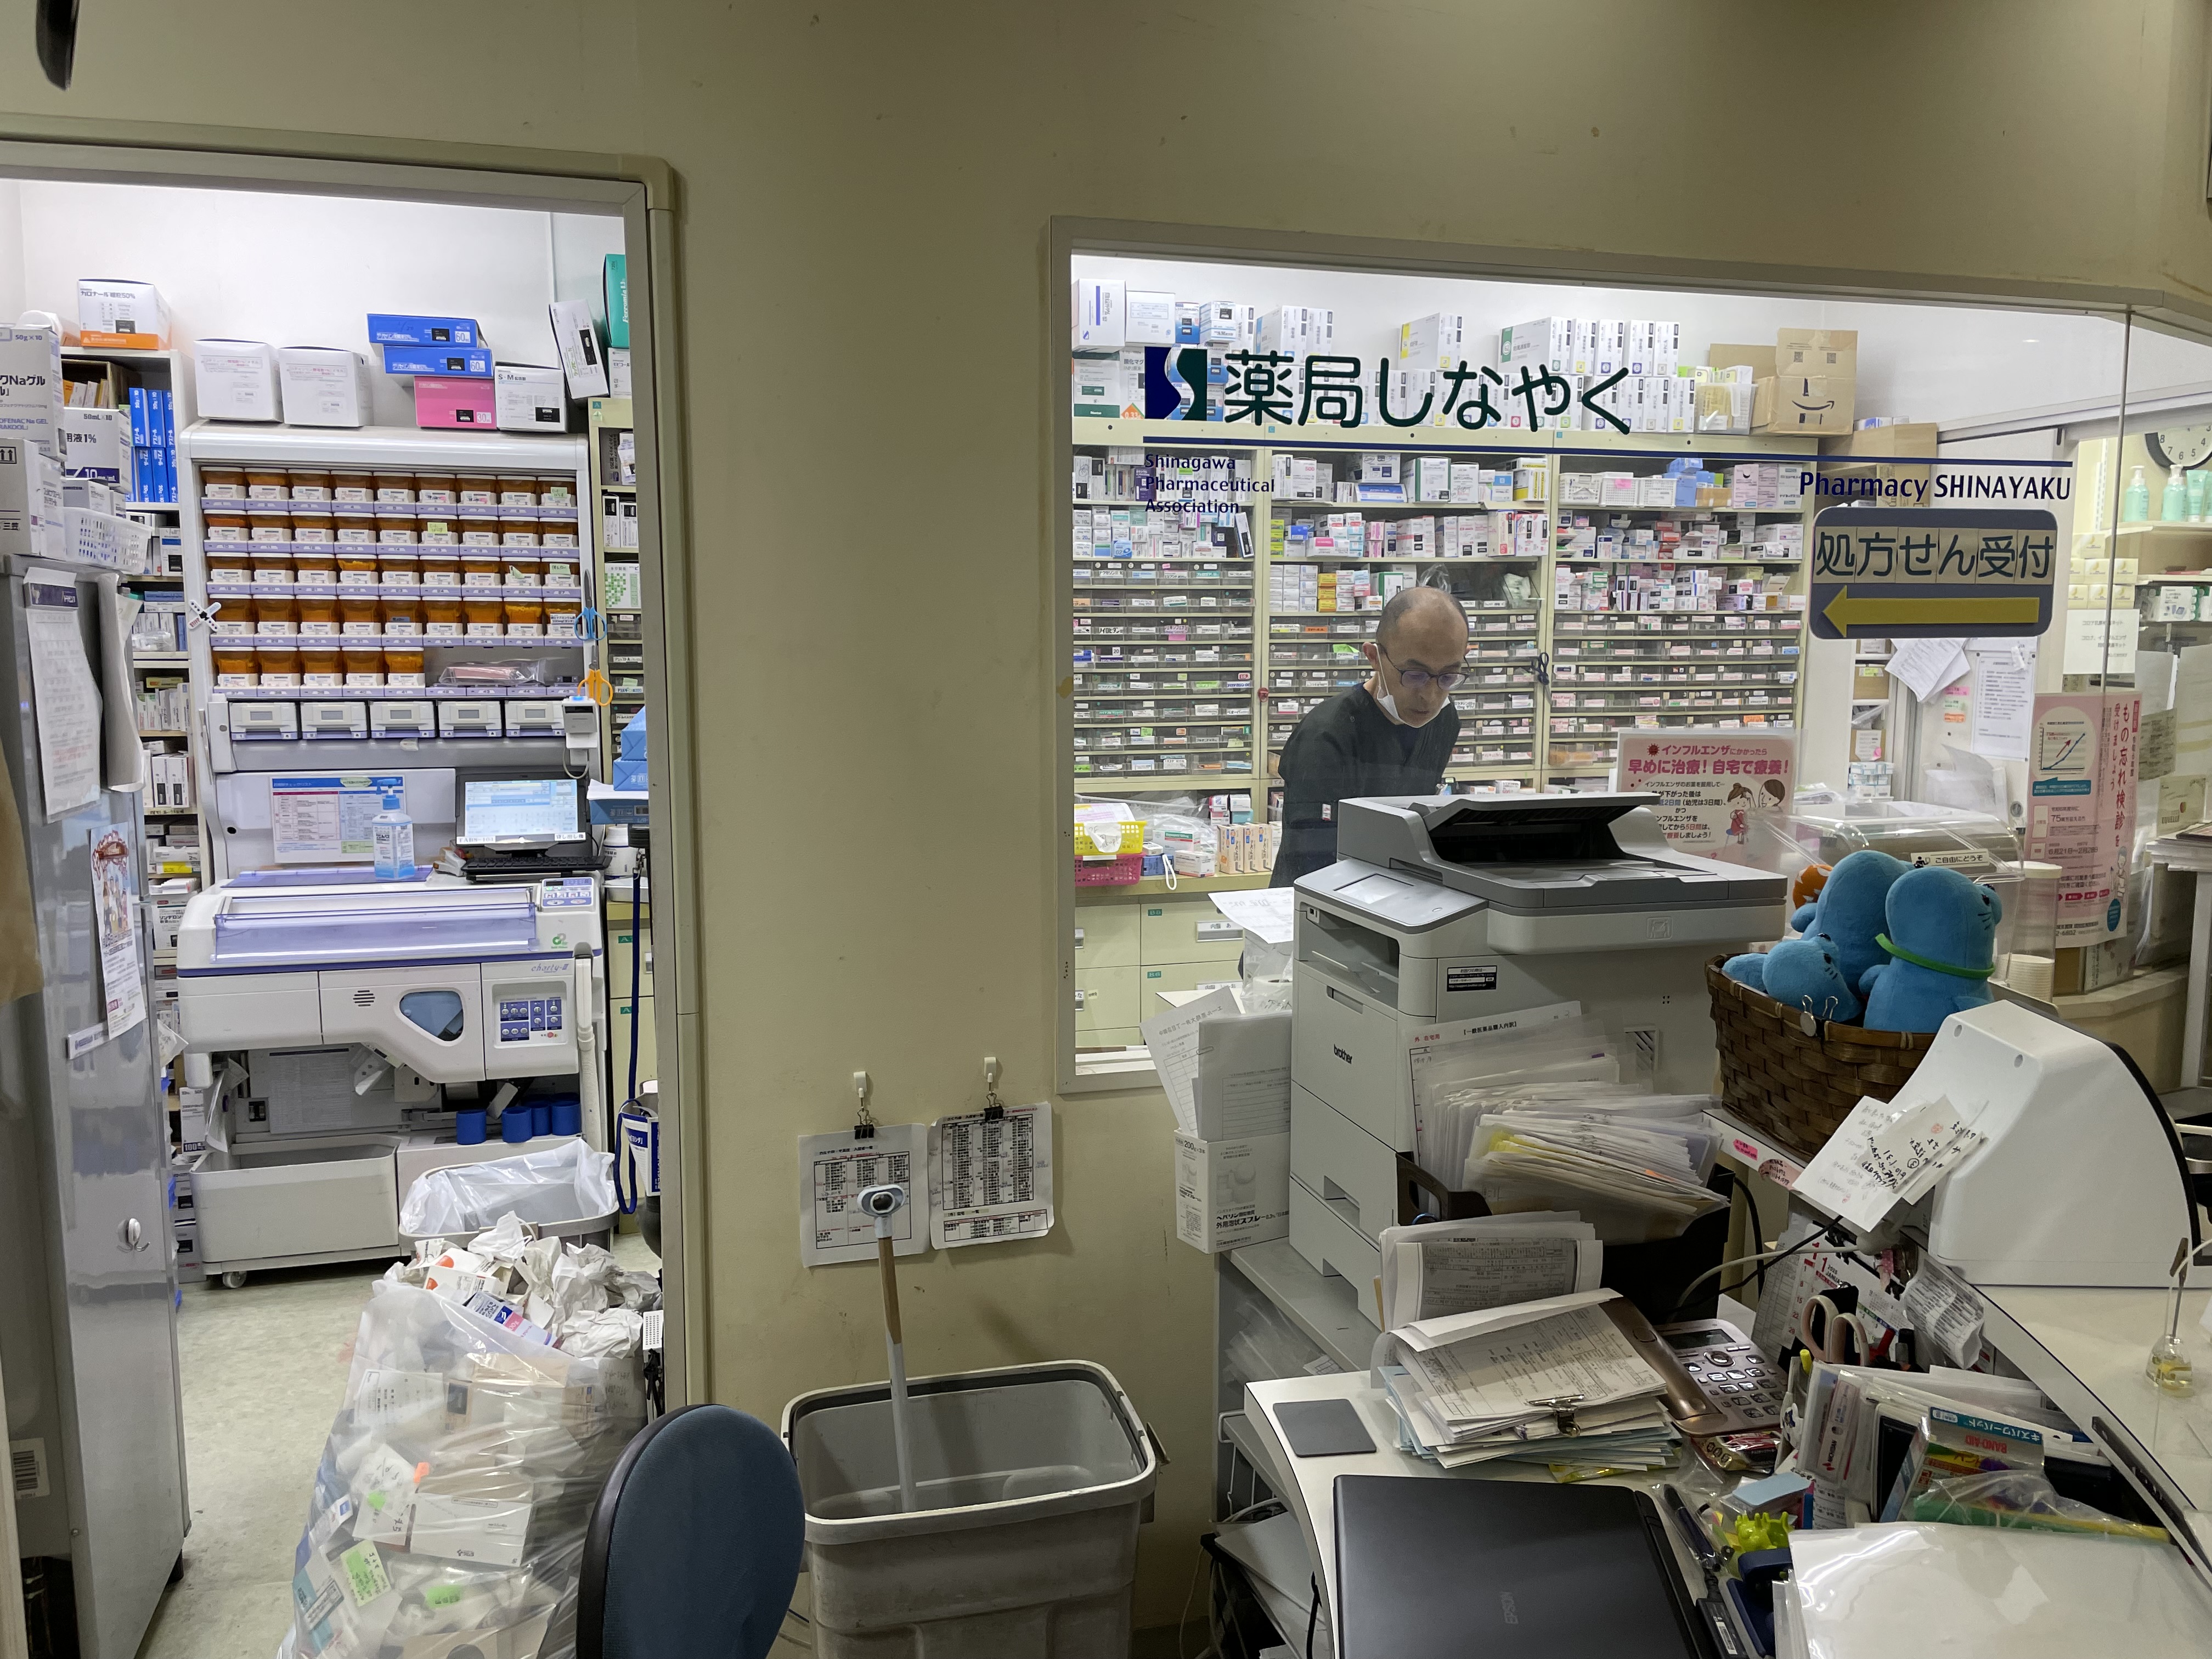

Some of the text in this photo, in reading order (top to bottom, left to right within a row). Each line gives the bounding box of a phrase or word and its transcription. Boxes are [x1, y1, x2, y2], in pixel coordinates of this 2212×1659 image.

[1224, 349, 1630, 435] 薬局しなやく
[2201, 438, 2205, 446] 4
[2168, 447, 2172, 455] 7
[2179, 452, 2183, 460] 6
[1145, 454, 1235, 471] Shinagawa
[1145, 477, 1274, 492] Pharmaceutical
[1800, 472, 2070, 501] Pharmacy SHINAYAKU
[1145, 498, 1239, 514] Association
[1816, 532, 2053, 578] 処方せん受付
[1661, 745, 1767, 755] インフルエンザにかかったら
[1333, 1044, 1352, 1064] brother
[1821, 1257, 1827, 1272] 1
[1968, 1419, 2040, 1442] キズパワーパッド
[1966, 1435, 2007, 1453] BAND-AID
